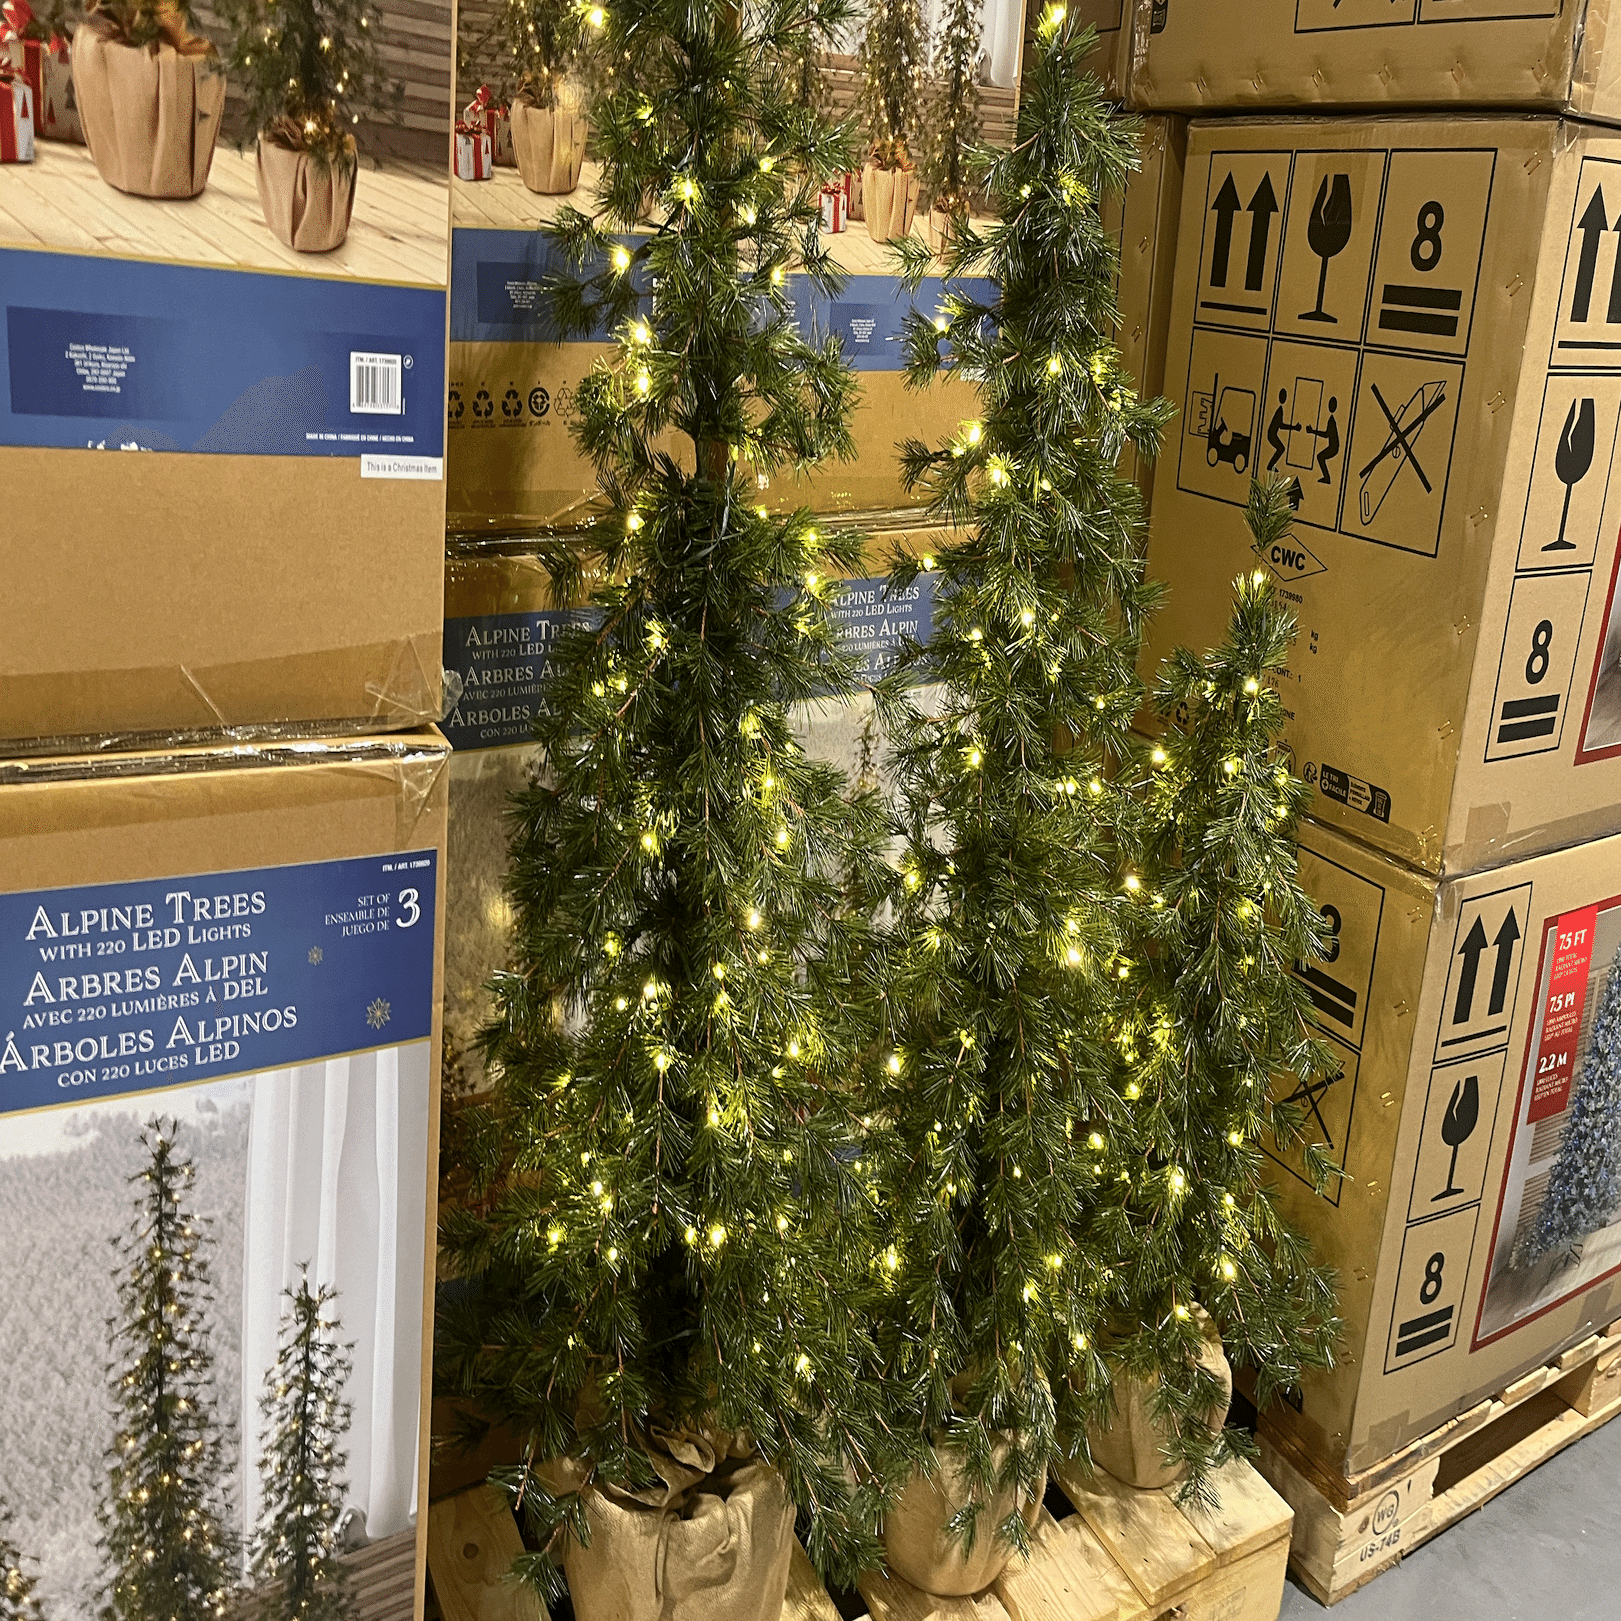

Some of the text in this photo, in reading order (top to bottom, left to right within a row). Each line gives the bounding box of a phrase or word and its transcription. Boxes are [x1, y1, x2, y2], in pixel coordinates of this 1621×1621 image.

[1410, 201, 1444, 271] 8
[367, 461, 438, 473] This is a Christmas Item
[1271, 545, 1306, 571] CWC
[865, 603, 885, 616] LED
[886, 603, 913, 615] LIGHTS
[465, 626, 531, 647] ALPINE
[879, 618, 919, 636] ALPIN
[472, 648, 499, 660] WITH
[501, 649, 516, 657] 220
[519, 641, 545, 657] LED
[1526, 619, 1553, 685] 8
[463, 665, 534, 687] ARBRES
[463, 690, 489, 701] AVEC
[490, 689, 506, 699] 220
[480, 727, 500, 739] CON
[357, 892, 391, 908] SET OF
[396, 887, 421, 928] 3
[25, 891, 267, 941] ALPINE TREES
[325, 906, 390, 926] ENSEMBLE DE
[342, 919, 390, 938] JUEGO DE
[1574, 928, 1588, 946] FT
[39, 923, 251, 962] WITH 220 LED LIGHTS
[23, 951, 269, 1006] ARBRES ALPIN
[23, 1008, 73, 1030] AVEC
[77, 1005, 107, 1022] 220
[111, 991, 200, 1018] LUMIÈRES
[223, 977, 269, 1001] DEL
[1564, 991, 1576, 1008] PI
[0, 1005, 297, 1075] ÁRBOLES ALPINOS
[57, 1040, 240, 1088] CON 220 LUCES LED
[1538, 1051, 1568, 1073] 2.2 M
[1420, 1252, 1445, 1305] 8
